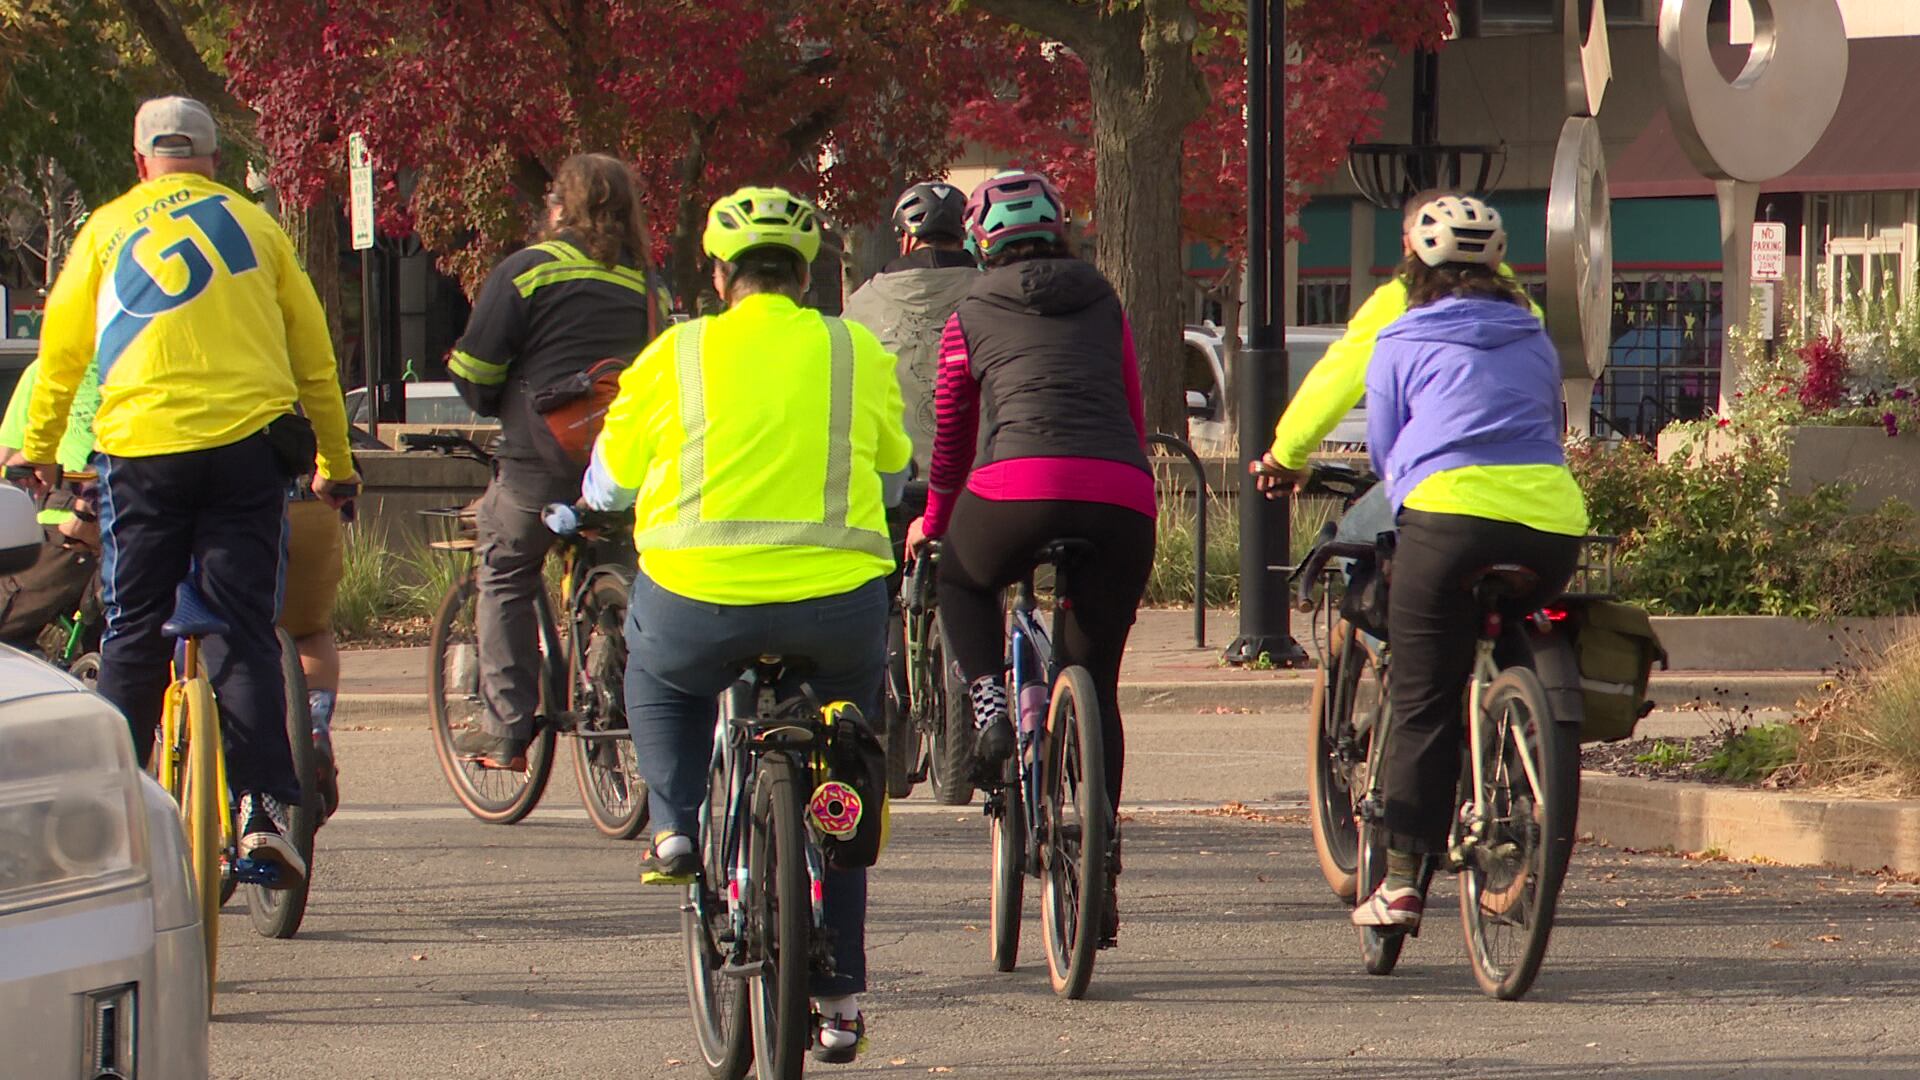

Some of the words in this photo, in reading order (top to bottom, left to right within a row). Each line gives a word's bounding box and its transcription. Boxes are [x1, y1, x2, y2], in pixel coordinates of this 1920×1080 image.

[134, 189, 190, 224] DYNO
[1761, 229, 1775, 240] NO
[1753, 241, 1782, 251] PARKING
[113, 194, 259, 316] GT
[1753, 253, 1781, 261] LOADING
